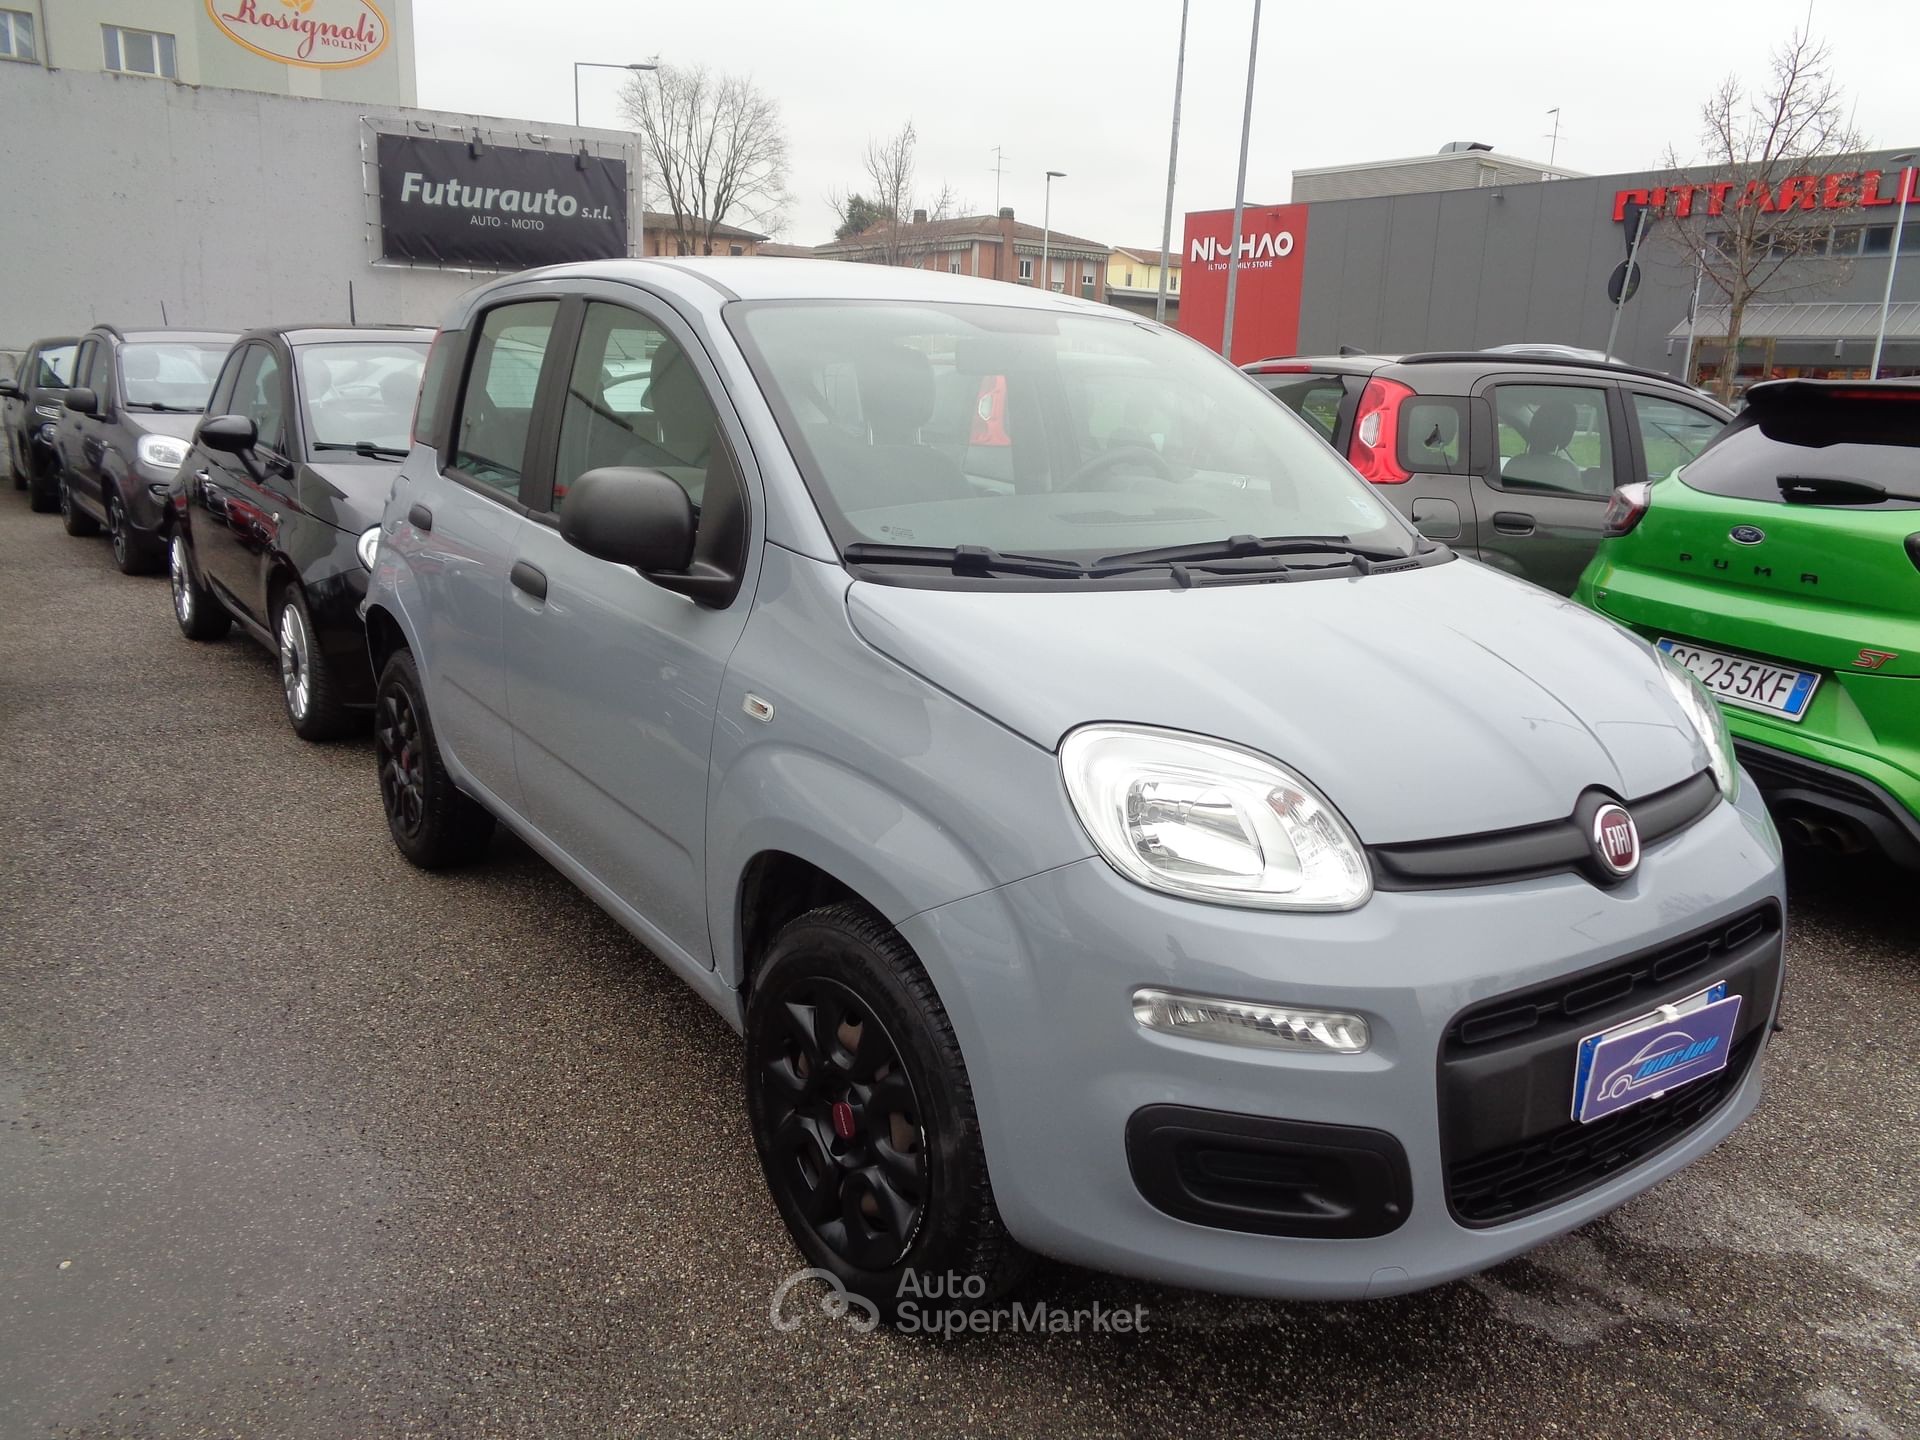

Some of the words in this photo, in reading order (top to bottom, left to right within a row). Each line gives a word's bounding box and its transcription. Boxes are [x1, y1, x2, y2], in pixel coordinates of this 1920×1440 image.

[222, 0, 377, 58] Rosignoli
[321, 37, 368, 52] MOLINI
[401, 172, 578, 217] Futurauto
[581, 205, 612, 220] s.r.l.
[470, 215, 500, 227] AUTO
[511, 218, 544, 231] MOTO
[1214, 262, 1227, 270] TUO
[1252, 260, 1273, 269] STORE
[1679, 553, 1818, 585] PUMA
[1852, 649, 1898, 669] ST
[1702, 657, 1795, 703] 255KF
[1605, 823, 1632, 857] FIAT
